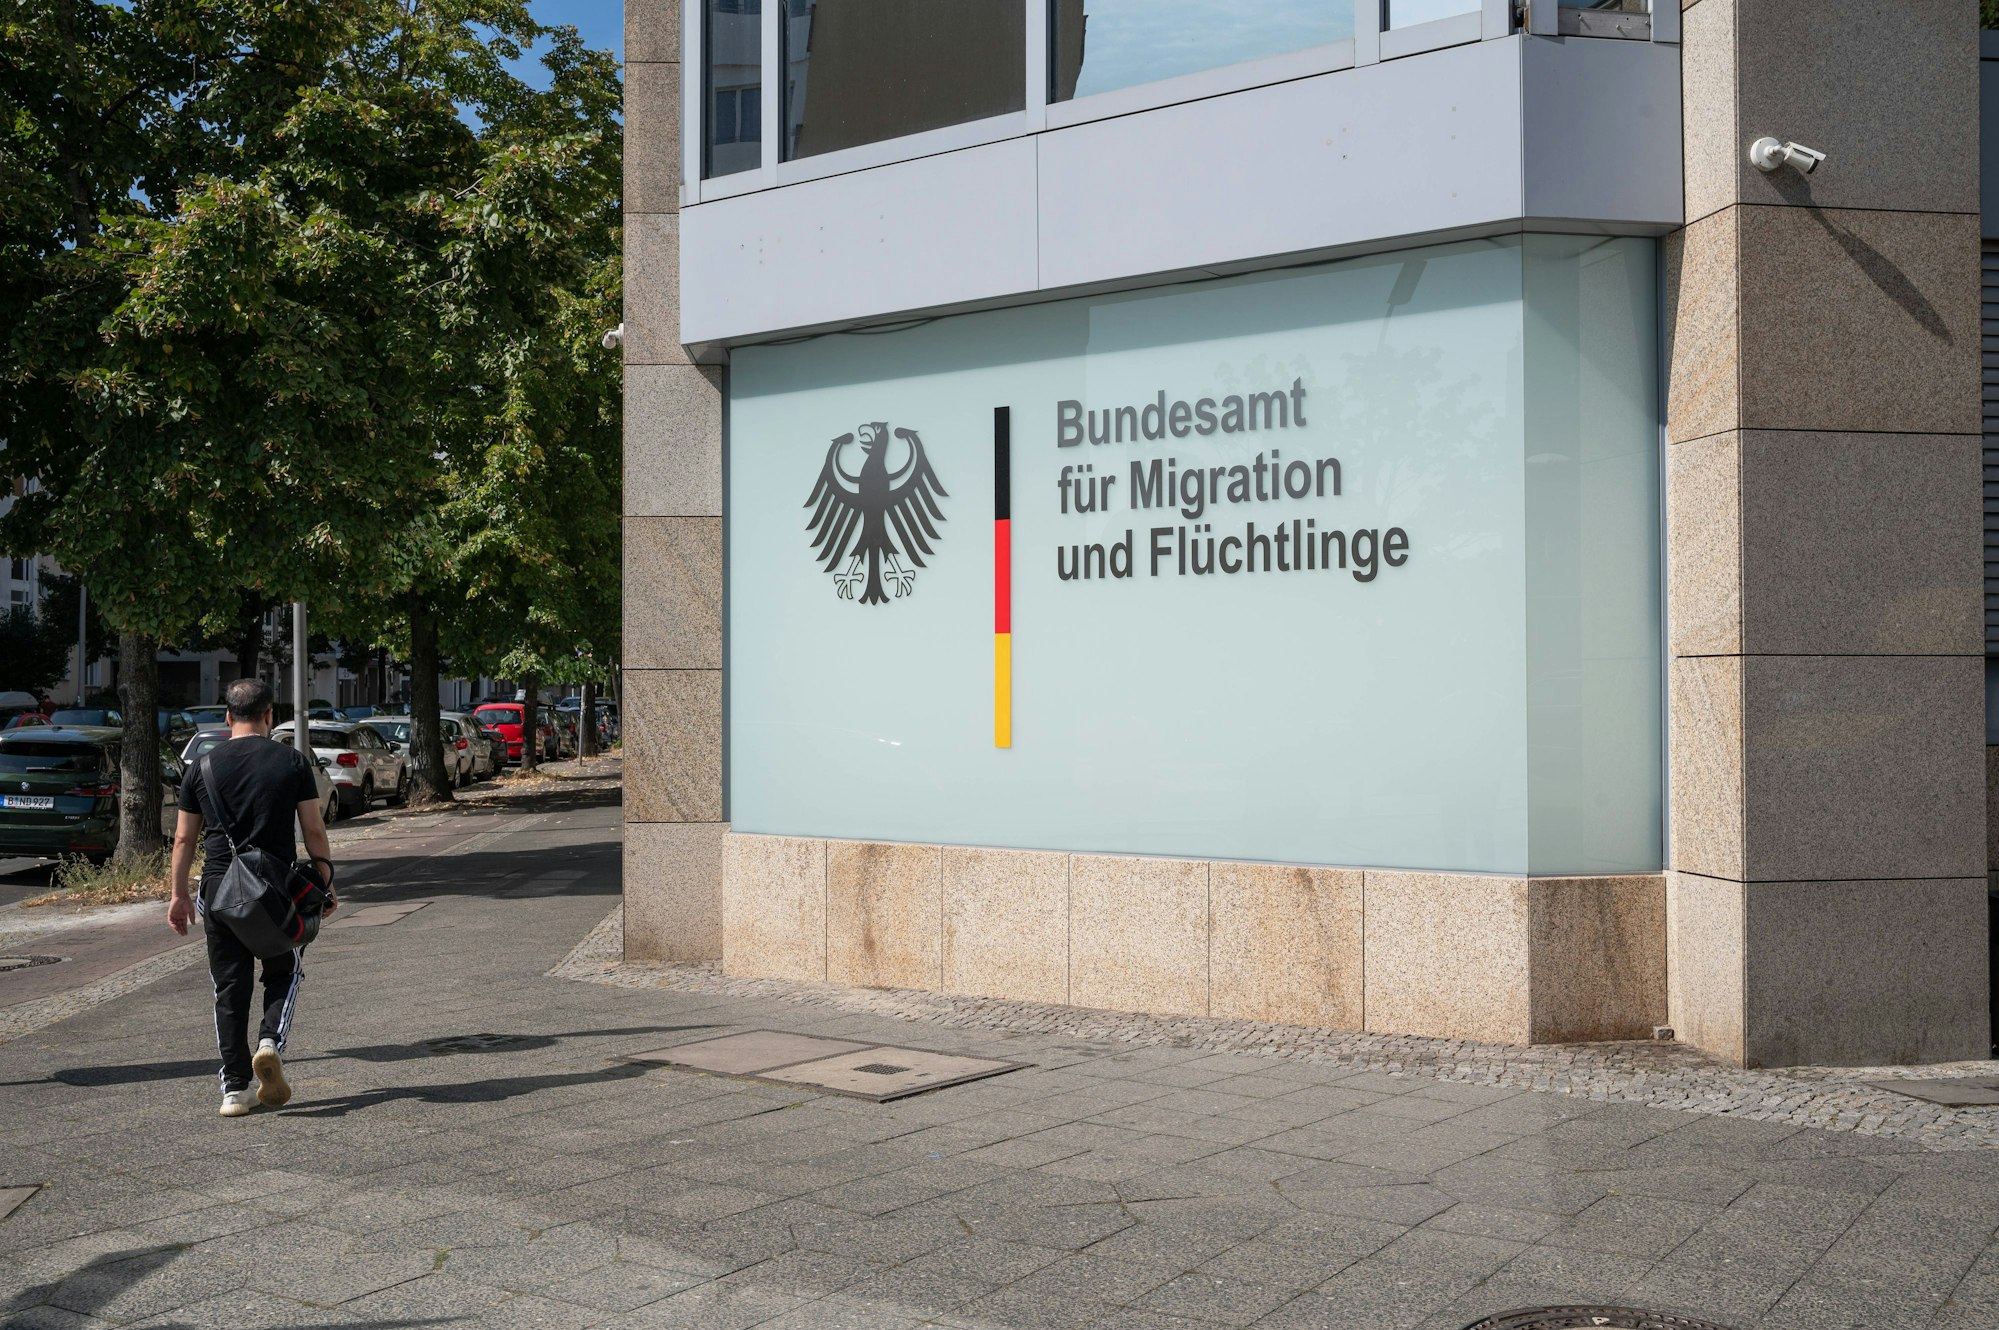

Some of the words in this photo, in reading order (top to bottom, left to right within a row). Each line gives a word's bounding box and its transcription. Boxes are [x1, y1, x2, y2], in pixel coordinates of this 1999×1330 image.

[1057, 376, 1307, 448] Bundesamt
[1057, 463, 1116, 514] für
[1130, 449, 1342, 520] Migration
[1057, 529, 1133, 581] und
[1150, 518, 1410, 583] Flüchtlinge
[8, 796, 14, 806] B
[33, 797, 50, 807] 927
